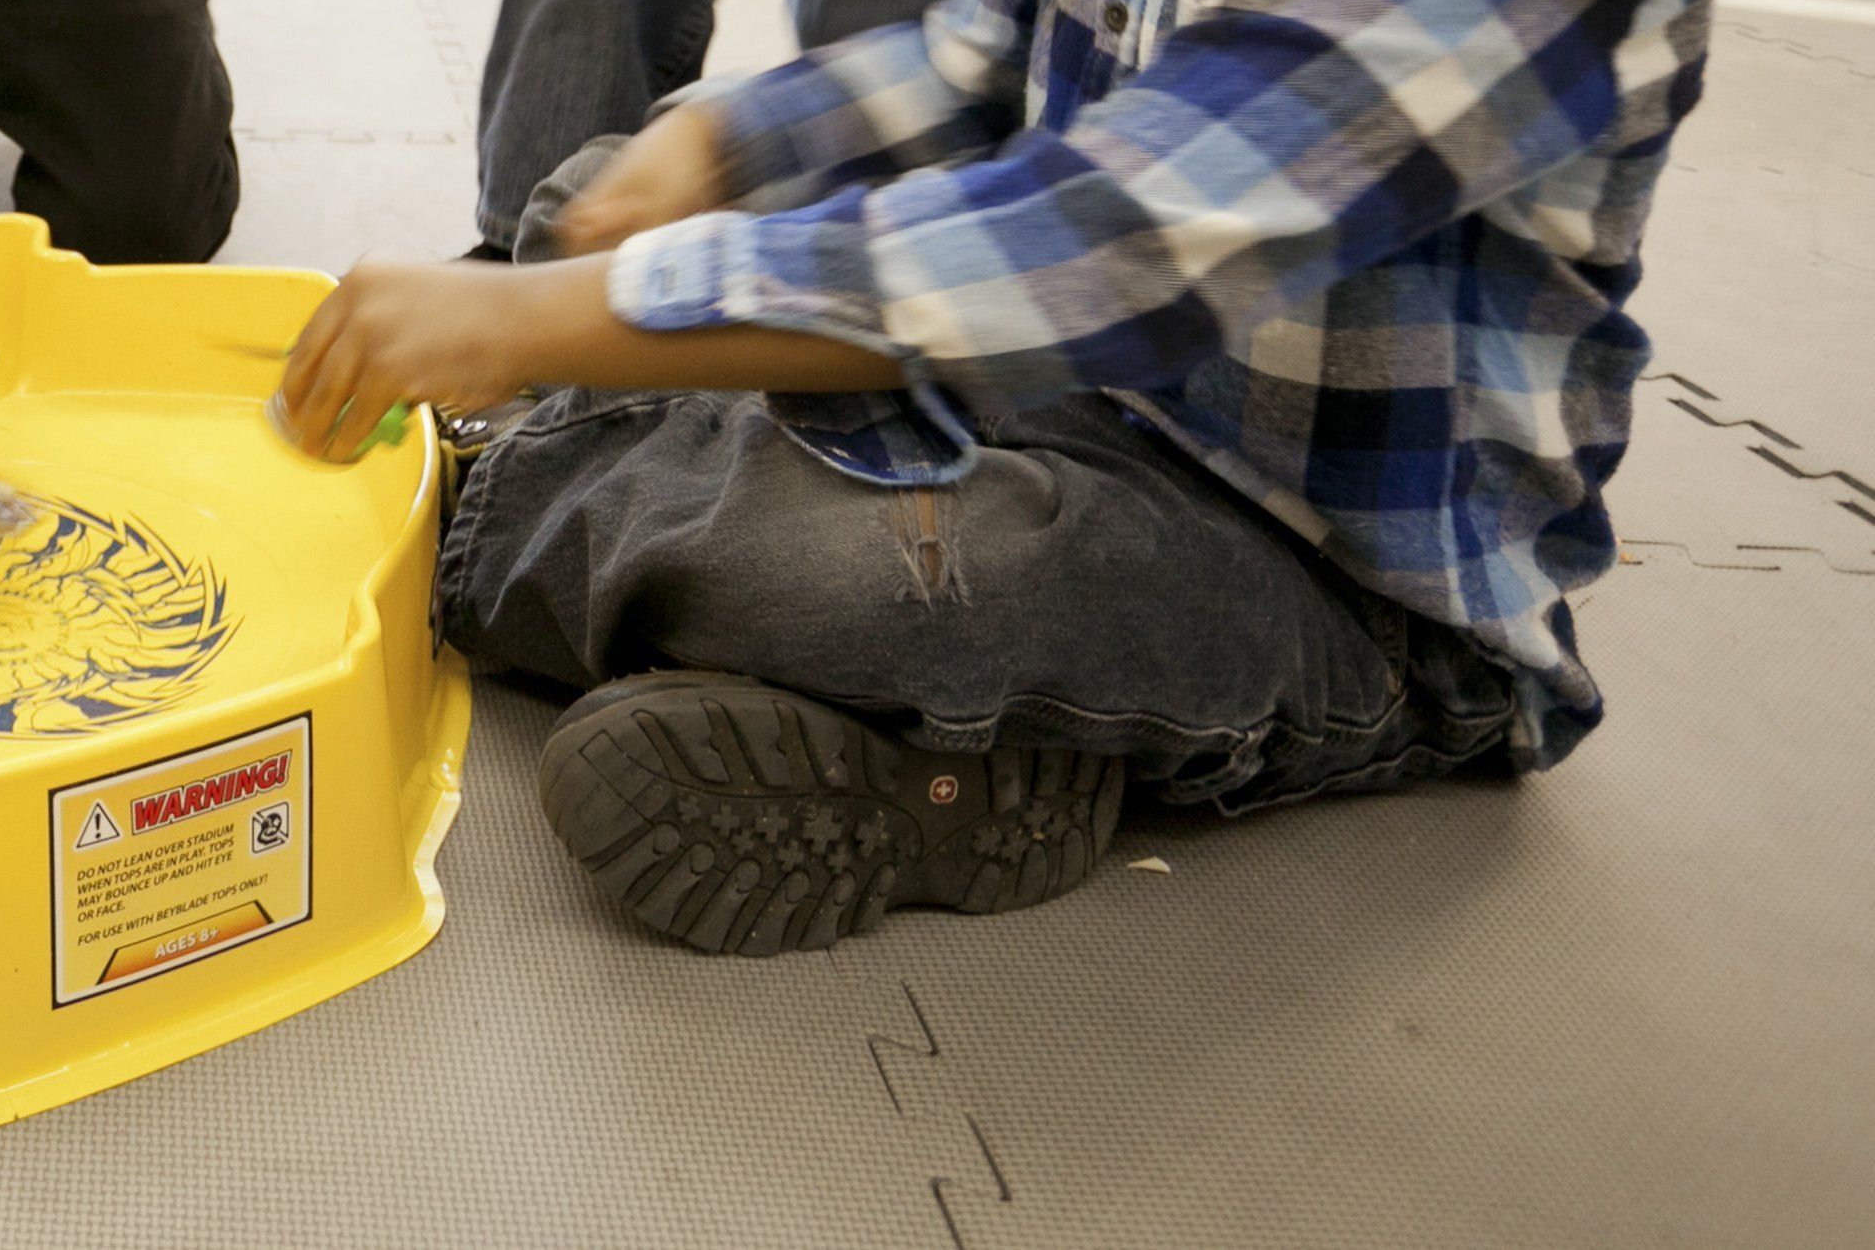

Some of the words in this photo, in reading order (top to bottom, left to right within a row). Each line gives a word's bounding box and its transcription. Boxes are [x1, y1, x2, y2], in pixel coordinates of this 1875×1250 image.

[133, 753, 289, 831] WARNING!
[77, 867, 95, 881] DO
[97, 859, 122, 876] NOT
[124, 851, 153, 867] LEAN
[155, 840, 185, 857] OVER
[187, 823, 235, 847] STADIUM
[77, 877, 111, 895] WHEN
[114, 869, 141, 886] TOPS
[143, 860, 164, 875] ARE
[166, 856, 177, 868] IN
[179, 847, 206, 864] PLAY.
[209, 837, 235, 852] TOPS
[77, 892, 103, 909] MAY
[105, 879, 150, 900] BOUNCE
[153, 874, 170, 886] UP
[170, 864, 194, 880] AND
[195, 857, 215, 871] HIT
[216, 851, 234, 865] EYE
[77, 909, 94, 923] OR
[96, 900, 126, 918] FACE.
[77, 931, 101, 946] FOR
[103, 924, 124, 939] USE
[126, 914, 154, 932] WITH
[156, 894, 209, 923] BEYBLADE
[211, 886, 237, 902] TOPS
[154, 931, 197, 960] AGES
[199, 926, 221, 943] 8+
